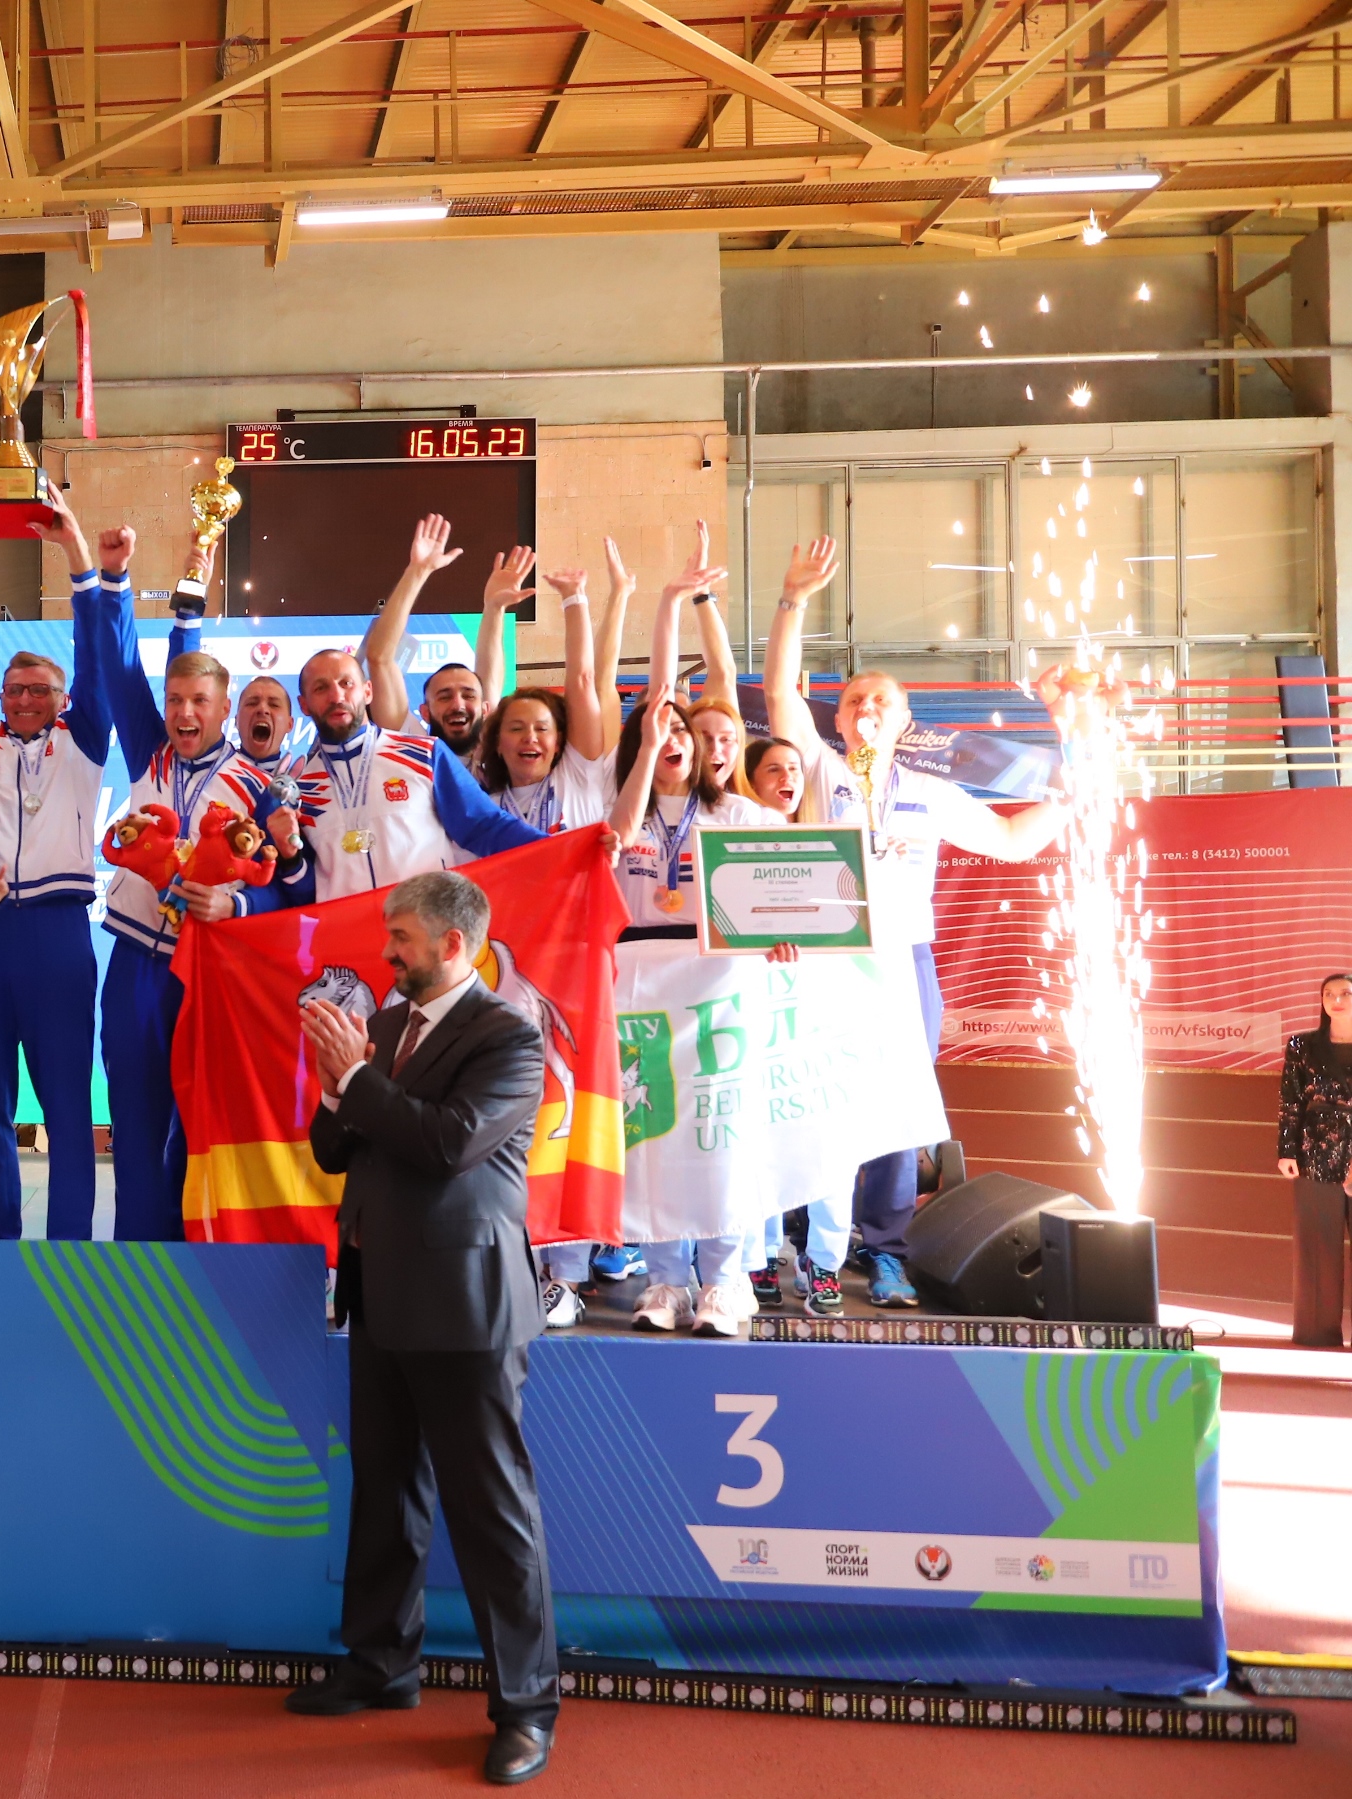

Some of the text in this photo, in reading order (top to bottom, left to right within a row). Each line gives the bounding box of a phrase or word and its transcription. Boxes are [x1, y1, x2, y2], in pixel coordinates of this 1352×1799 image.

[240, 433, 276, 461] 25
[409, 428, 524, 457] 16.05.23
[142, 591, 168, 599] ЫХОД
[914, 758, 952, 773] ARMS
[951, 856, 982, 866] ВФСК
[1162, 852, 1188, 860] тел.:
[1191, 850, 1199, 859] 8
[1202, 848, 1241, 861] (3412)
[1244, 846, 1290, 858] 500001
[753, 867, 812, 880] ДИПЛОМ
[714, 1393, 785, 1508] 3
[825, 1543, 860, 1554] СПОРТ
[826, 1555, 869, 1566] НОРМА
[1128, 1554, 1169, 1580] ГТО
[827, 1565, 869, 1577] ЖИЗНИ
